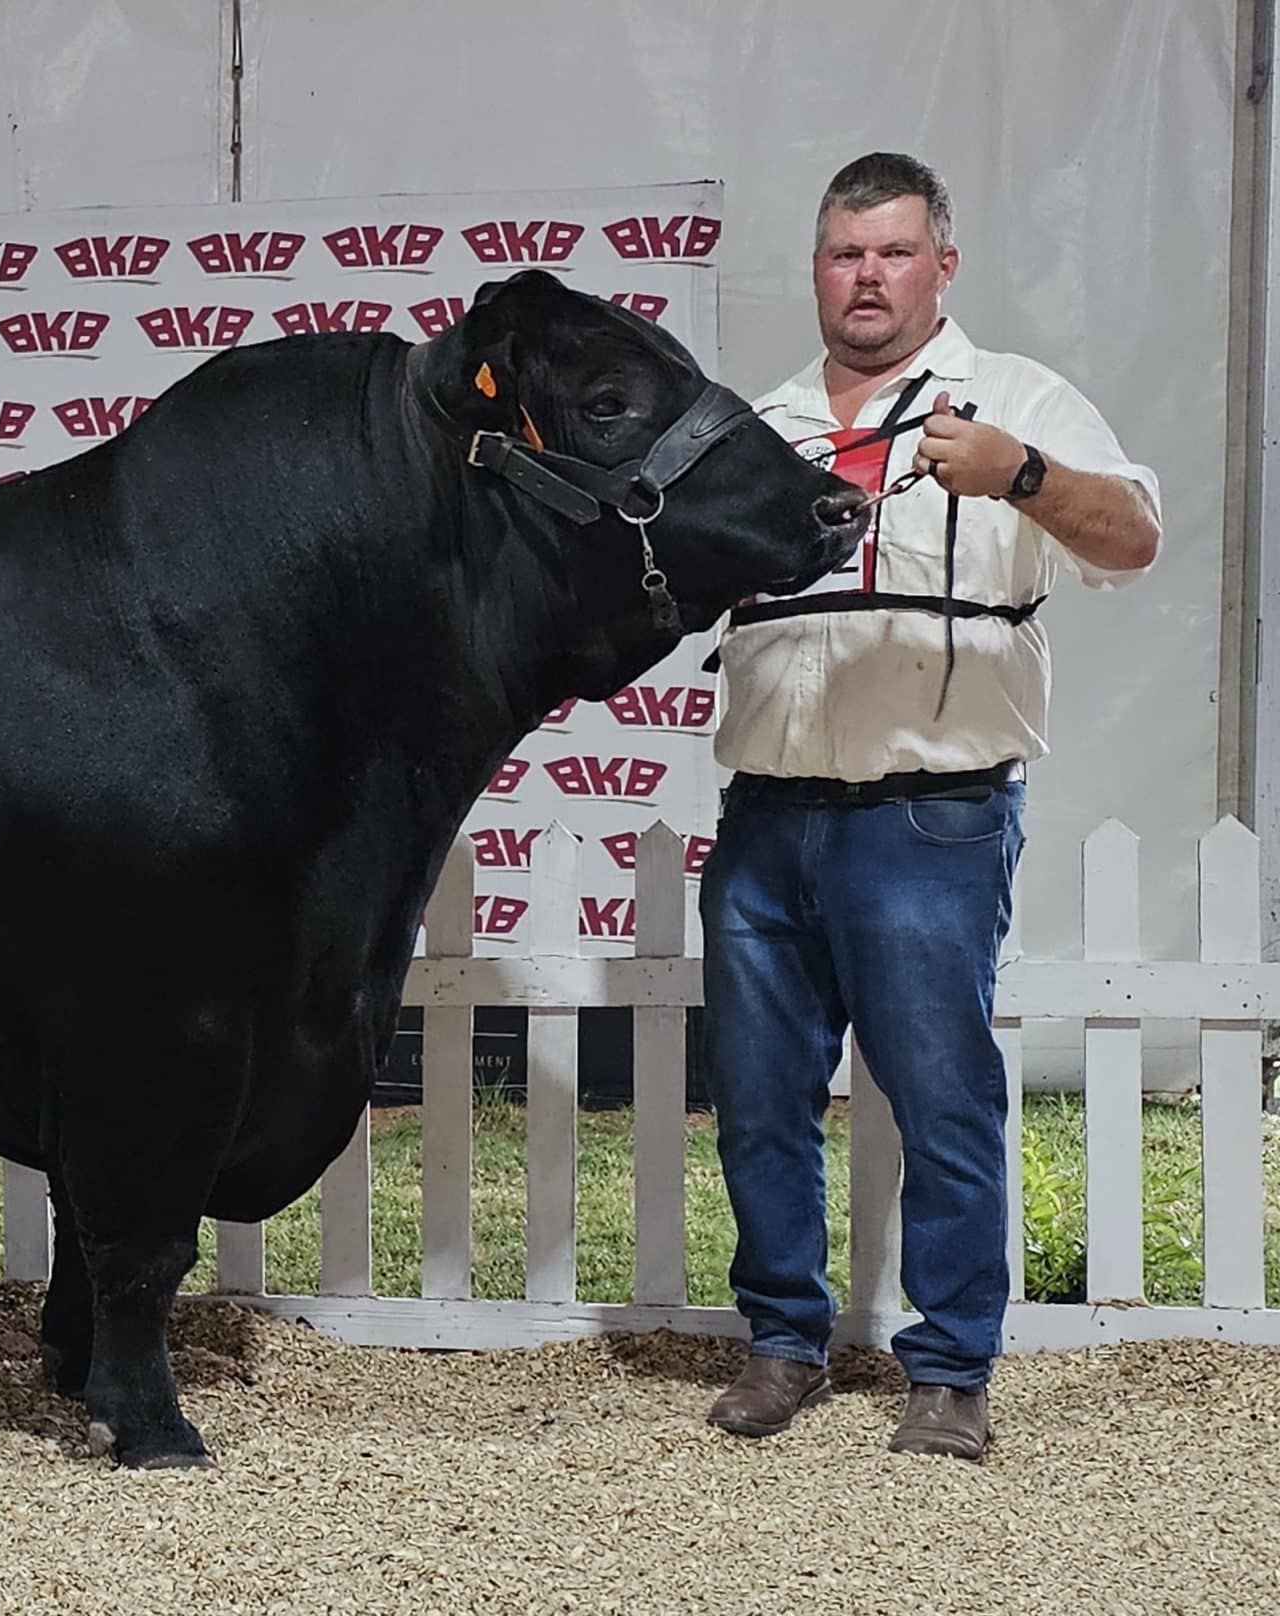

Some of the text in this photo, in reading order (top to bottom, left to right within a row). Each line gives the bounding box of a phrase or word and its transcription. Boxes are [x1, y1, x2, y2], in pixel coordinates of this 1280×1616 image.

[54, 236, 170, 277] BKB
[186, 231, 307, 272] BKB
[323, 224, 445, 266] BKB
[462, 220, 586, 262] BKB
[602, 215, 719, 258] BKB
[136, 306, 255, 347] BKB
[272, 300, 393, 334] BKB
[606, 686, 715, 727] BKB
[543, 757, 668, 798] BKB
